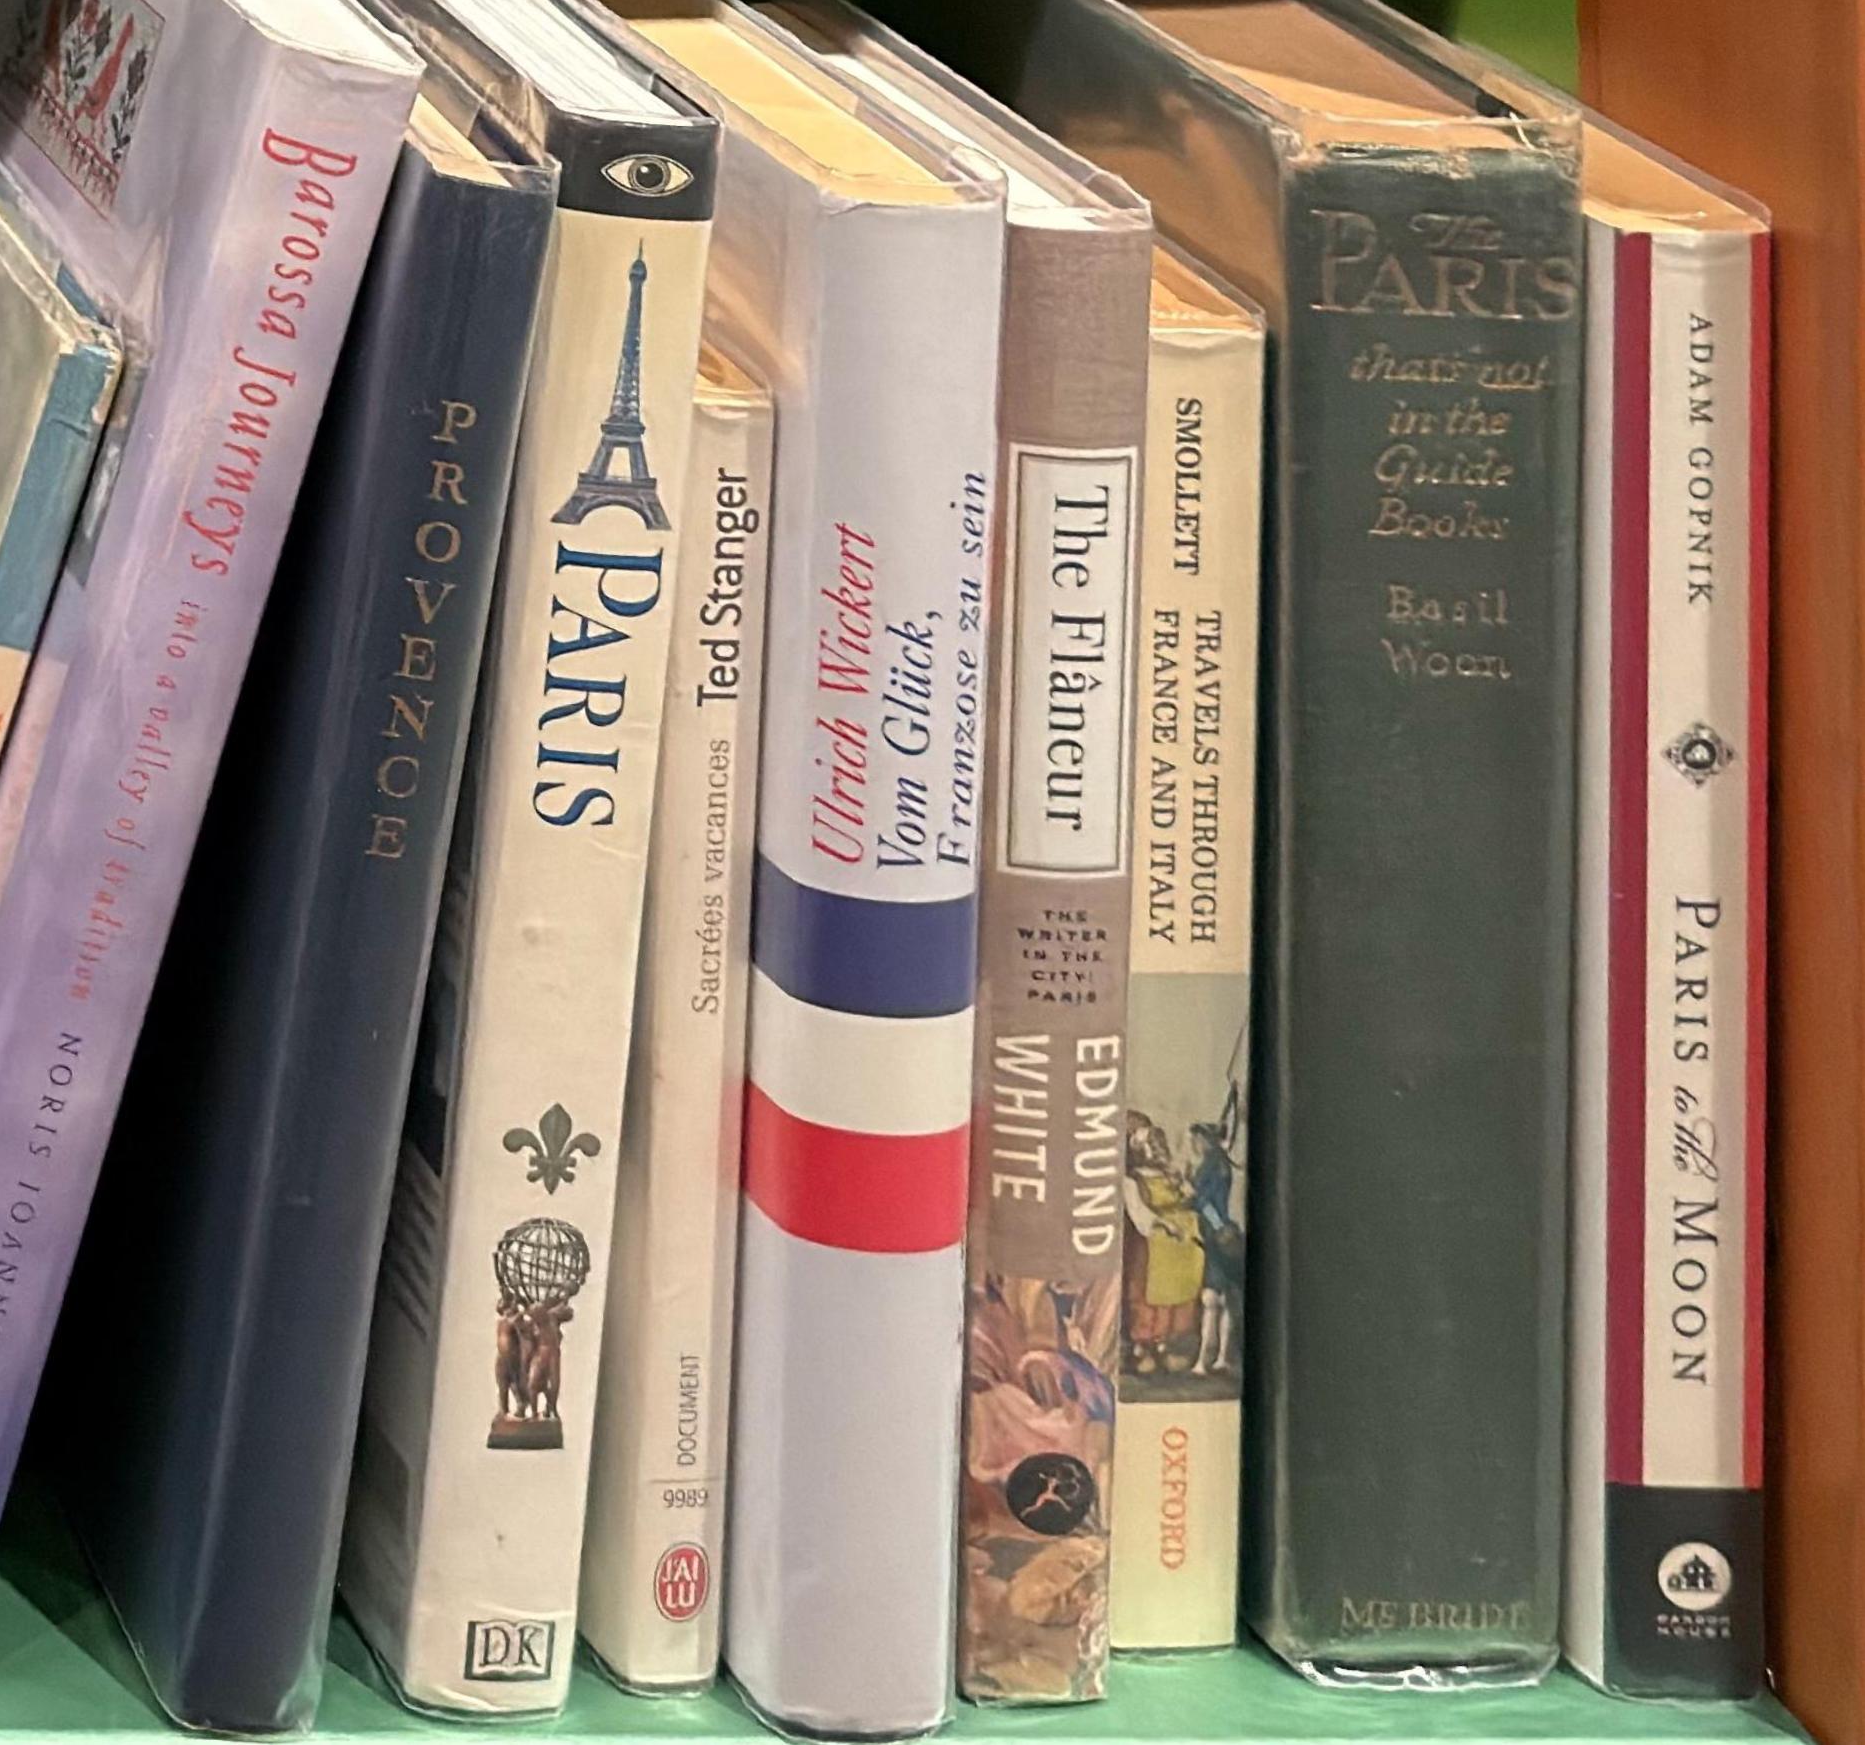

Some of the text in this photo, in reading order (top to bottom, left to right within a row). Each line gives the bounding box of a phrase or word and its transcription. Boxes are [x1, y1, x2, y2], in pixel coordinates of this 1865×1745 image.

[1310, 209, 1579, 322] PARIS
[117, 127, 358, 806] Barossa Journeys valley
[1172, 398, 1204, 576] SMOLLETT
[1373, 443, 1515, 496] Guide
[1444, 397, 1513, 437] the
[1686, 312, 1716, 606] ADAM GOPNIK
[1368, 496, 1510, 541] Books
[1385, 583, 1509, 624] Basil
[365, 398, 479, 862] PROVENCE
[531, 539, 664, 830] PARIS
[810, 521, 878, 867] Ulrich Wickert
[937, 471, 989, 868] Franzose zu sein
[1045, 484, 1111, 832] The Flâneur
[1380, 638, 1512, 680] Woon
[692, 466, 760, 1015] Sacrées vacances Ted Stanger
[876, 607, 943, 871] Vom Glück,
[1146, 609, 1180, 945] FRANCE AND ITALY
[1188, 609, 1223, 945] TRAVELS THROUGH
[28, 1032, 82, 1160] NORIS
[992, 1032, 1051, 1203] WHITE
[1071, 1034, 1120, 1257] EDMUND
[1671, 895, 1722, 1386] PARIS to MOON
[662, 1489, 709, 1509] 9989
[678, 1354, 703, 1467] DOCUMENT
[1159, 1426, 1189, 1571] OXFORD
[665, 1581, 696, 1608] LU
